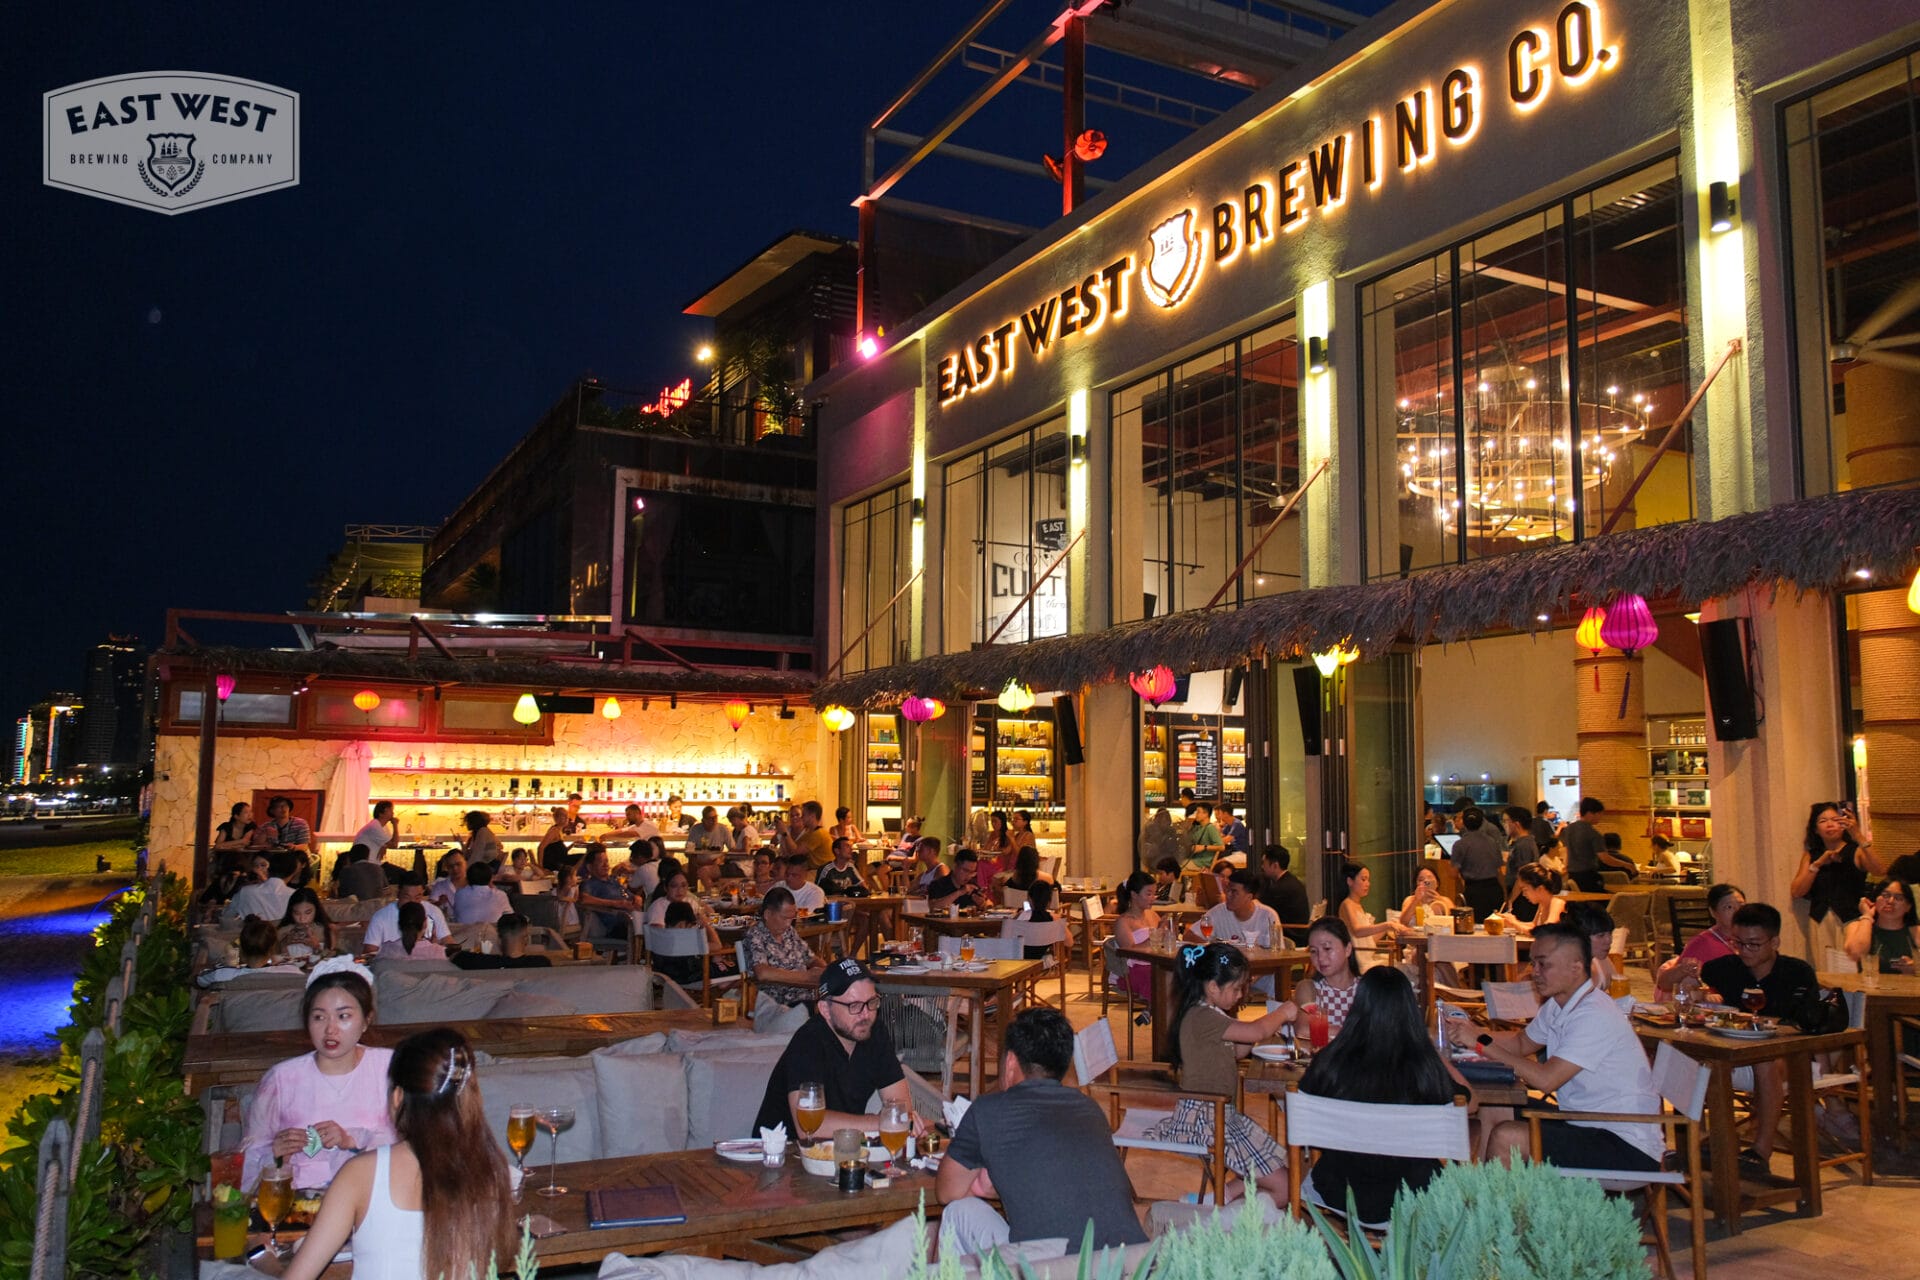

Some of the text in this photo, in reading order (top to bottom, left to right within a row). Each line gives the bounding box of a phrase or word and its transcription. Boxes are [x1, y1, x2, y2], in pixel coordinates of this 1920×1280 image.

[938, 2, 1617, 405] EAST WEST BREWING CO.
[1042, 521, 1065, 533] EAST
